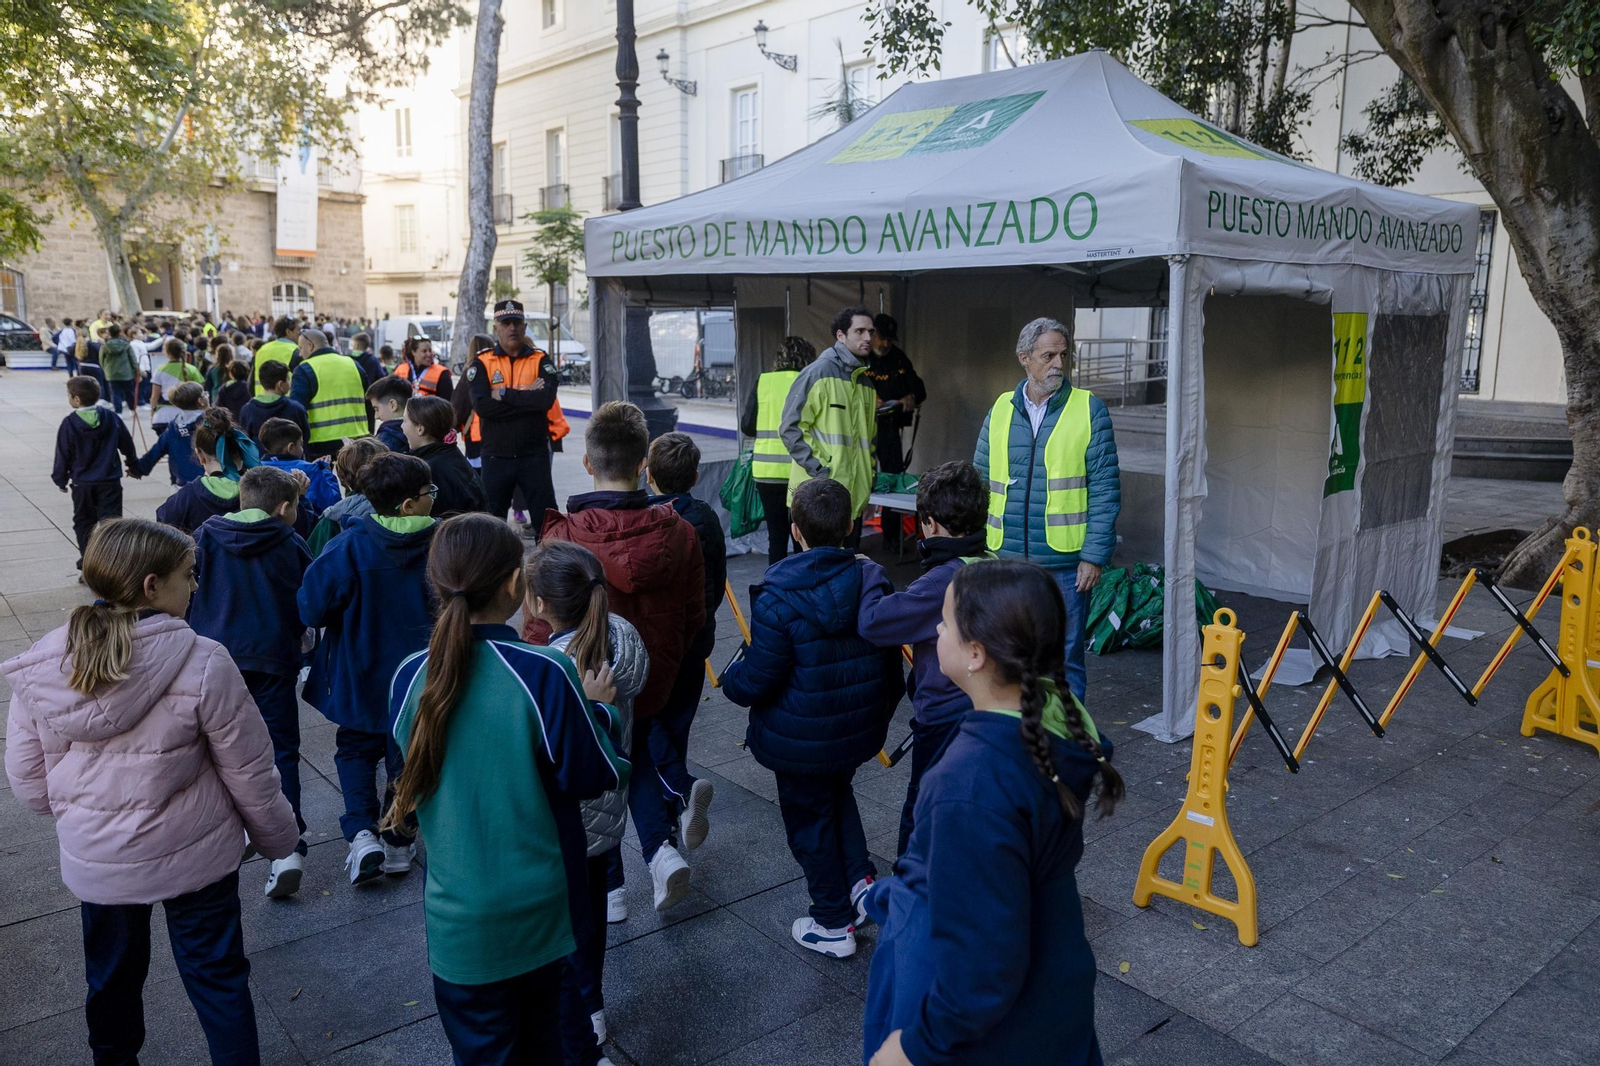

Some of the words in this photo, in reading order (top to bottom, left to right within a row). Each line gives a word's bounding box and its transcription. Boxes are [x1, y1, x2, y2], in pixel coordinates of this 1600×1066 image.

[1161, 130, 1225, 145] 112
[612, 224, 696, 262] PUESTO
[704, 221, 737, 257] DE
[745, 215, 868, 257] MANDO
[877, 191, 1098, 254] AVANZADO
[1207, 190, 1291, 238] PUESTO
[1296, 202, 1373, 244] MANDO
[1375, 215, 1463, 254] AVANZADO
[1086, 250, 1121, 258] MASTERTENT
[1333, 337, 1364, 365] 112
